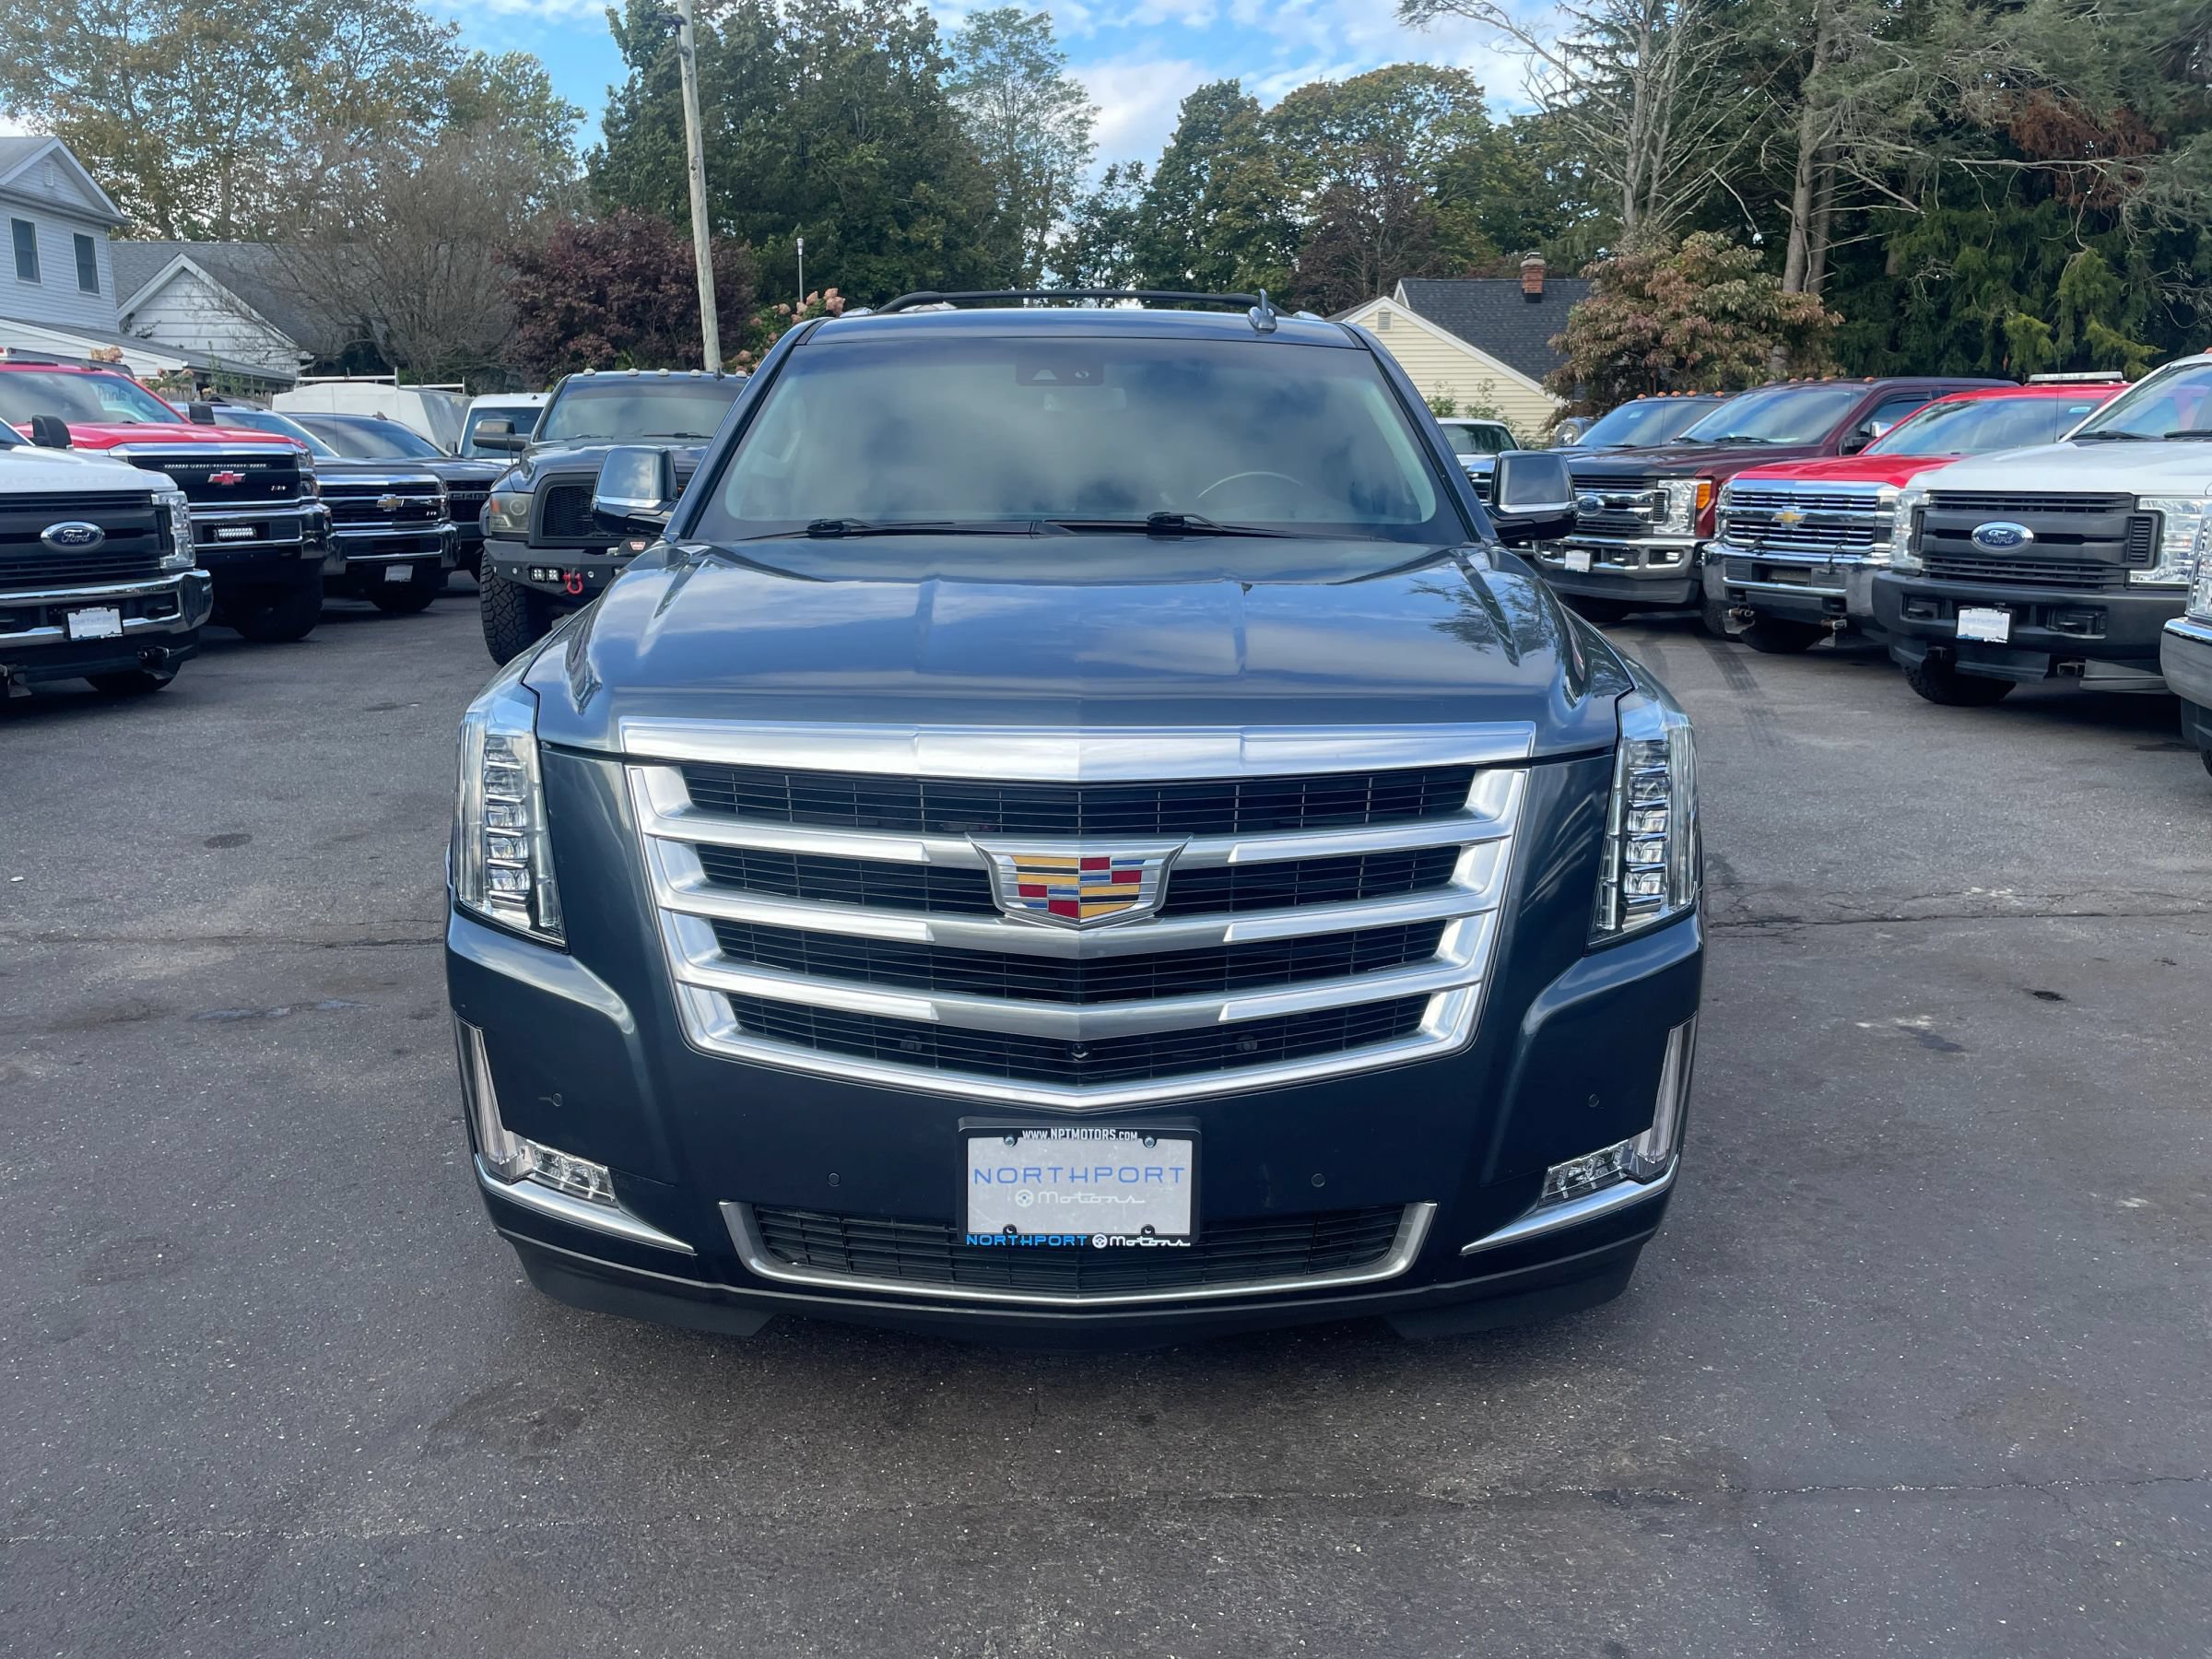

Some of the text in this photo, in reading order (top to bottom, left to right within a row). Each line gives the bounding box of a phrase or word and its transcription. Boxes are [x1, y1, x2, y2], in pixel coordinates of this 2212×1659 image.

[61, 529, 90, 543] Ford
[1985, 529, 2015, 545] Ford
[1022, 1128, 1138, 1141] WWW.NPTMOTORS.COM
[974, 1167, 1185, 1184] NORTHPORT
[966, 1234, 1088, 1246] NORTHPORT
